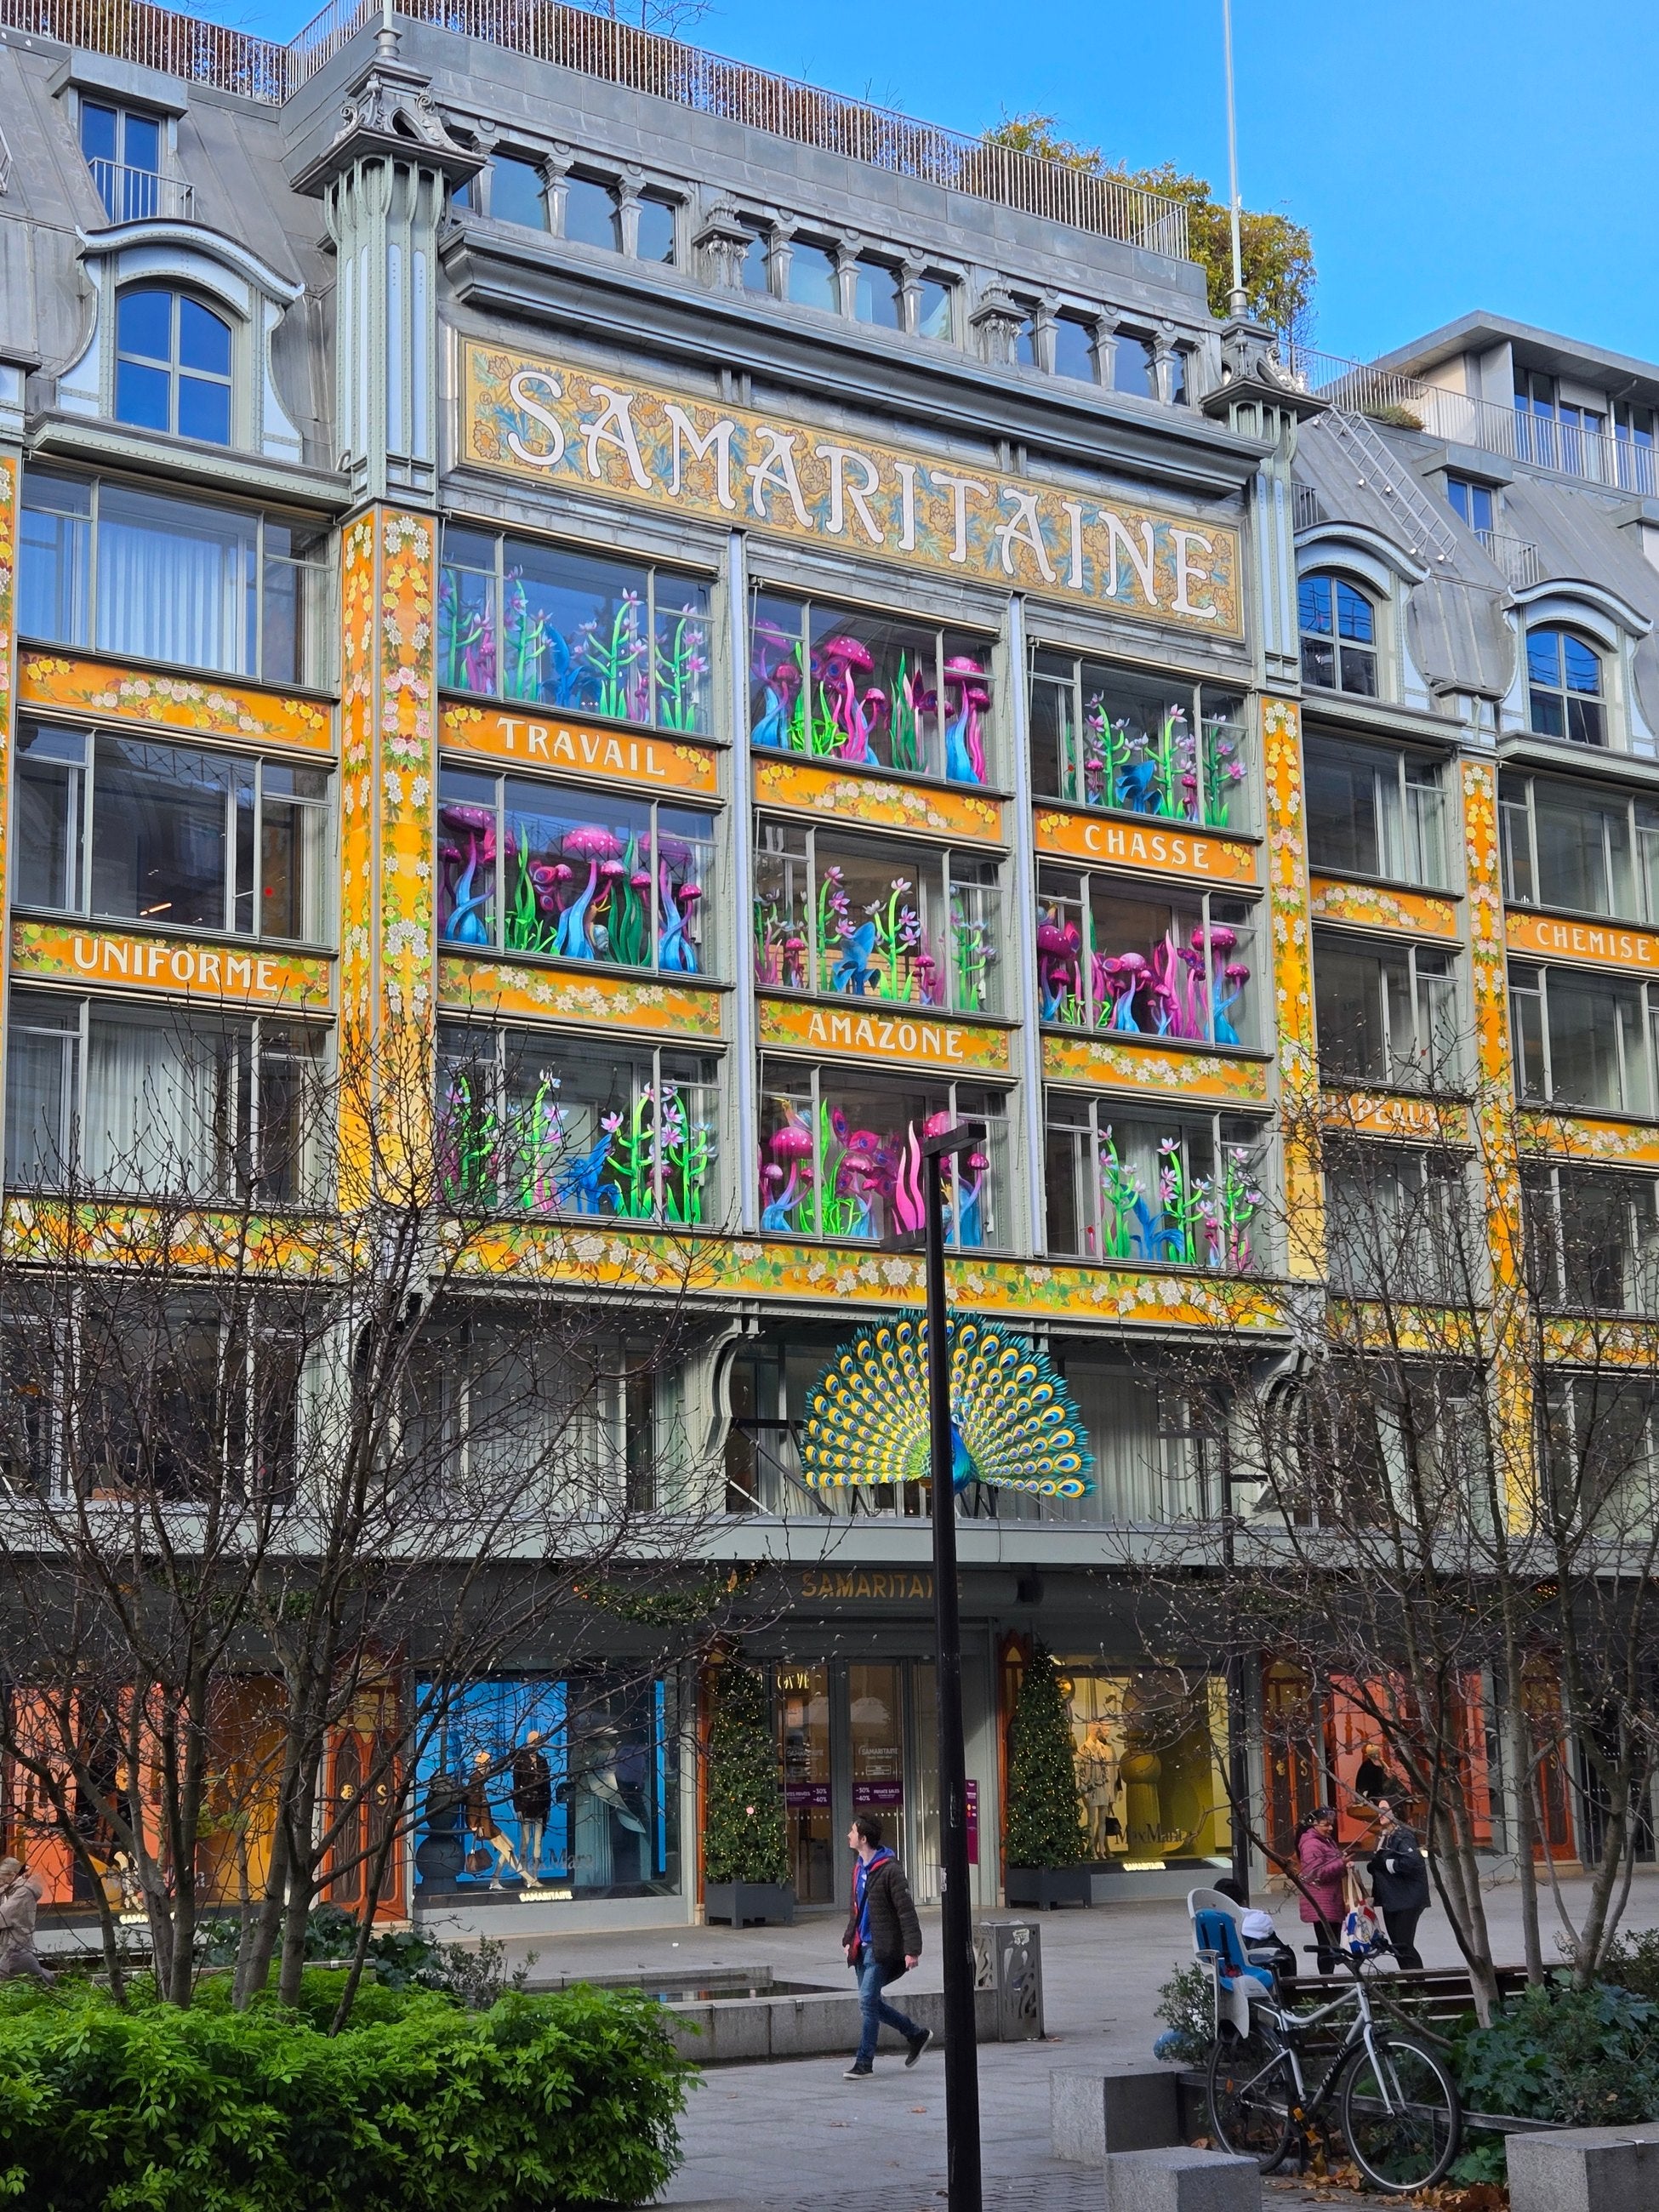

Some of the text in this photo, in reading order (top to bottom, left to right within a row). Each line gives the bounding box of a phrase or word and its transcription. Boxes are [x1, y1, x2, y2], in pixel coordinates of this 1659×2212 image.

[507, 370, 1217, 619] SAMARITAINE
[497, 716, 665, 776] TRAVAIL
[1084, 824, 1210, 869] CHASSE
[74, 937, 278, 992] UNIFORME
[1536, 922, 1651, 962] CHEMISE
[807, 1012, 964, 1059] AMAZONE
[801, 1573, 963, 1599] SAMARITAI
